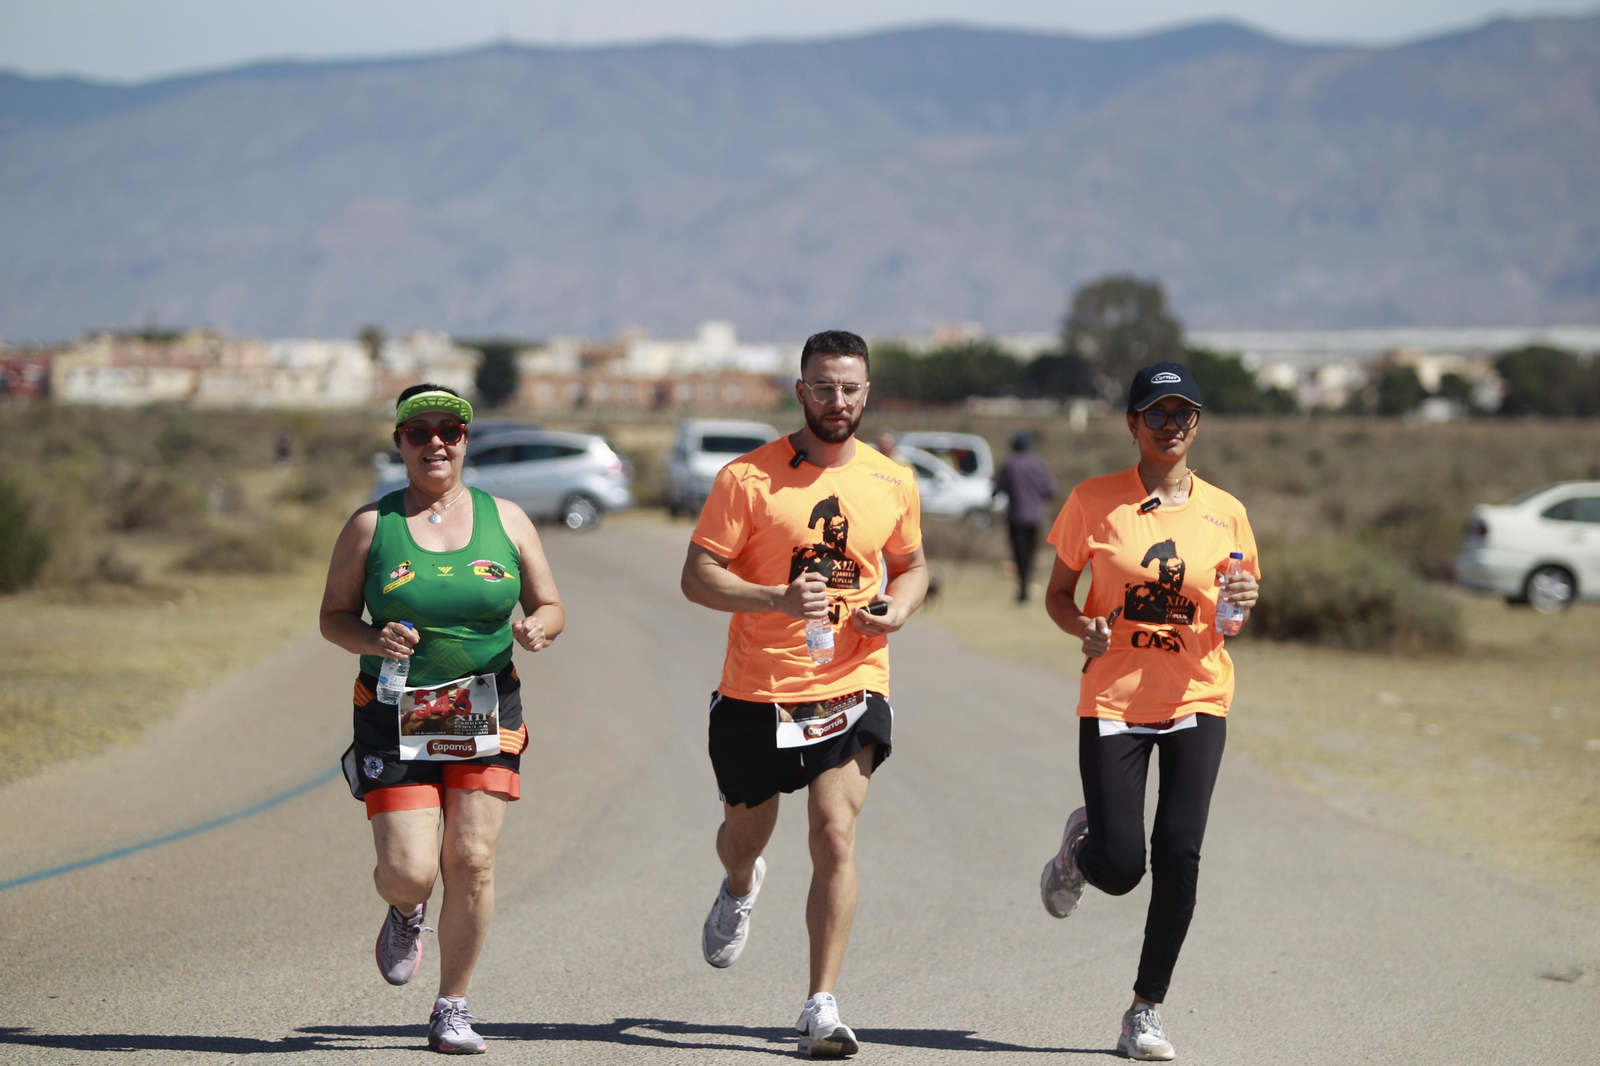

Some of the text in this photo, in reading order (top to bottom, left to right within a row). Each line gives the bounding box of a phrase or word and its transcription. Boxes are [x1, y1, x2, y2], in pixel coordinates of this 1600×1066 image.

[832, 559, 855, 571] XIII
[1166, 595, 1190, 606] XIII
[413, 689, 473, 717] 545
